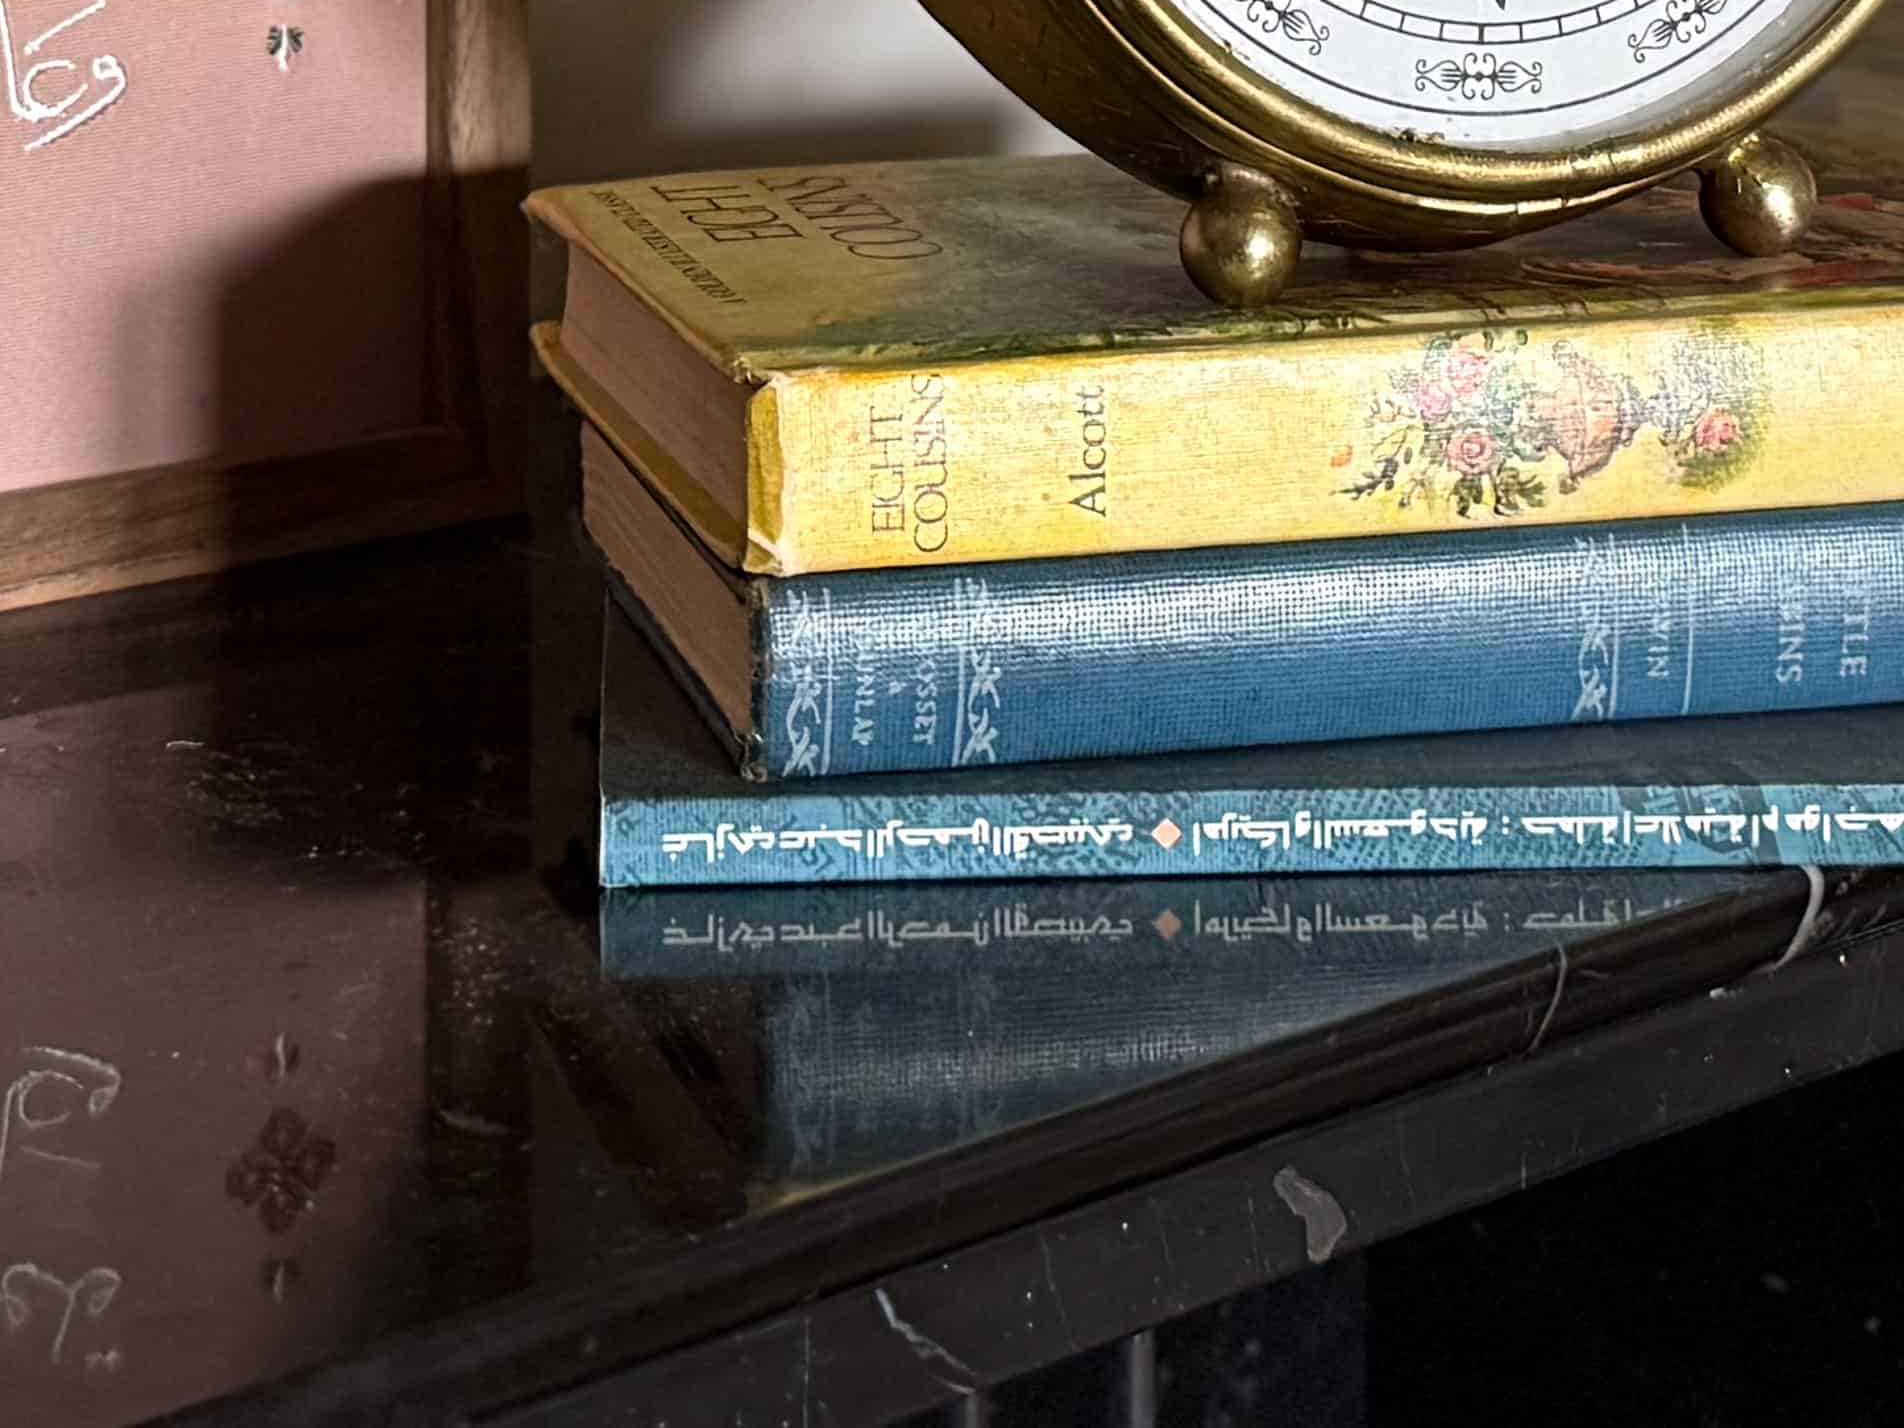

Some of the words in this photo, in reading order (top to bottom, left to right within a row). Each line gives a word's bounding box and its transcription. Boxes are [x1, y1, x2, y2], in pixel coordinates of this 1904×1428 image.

[649, 180, 804, 248] EIGHT
[756, 173, 946, 261] COUSINS
[871, 405, 906, 534] EIGHT
[910, 371, 950, 555] COUSINS
[1069, 385, 1108, 518] Alcott
[661, 823, 775, 863] غازي
[779, 822, 862, 851] عبد
[867, 818, 990, 858] الرحمن
[992, 818, 1134, 860] القصيبي
[1520, 814, 1619, 846] حملة
